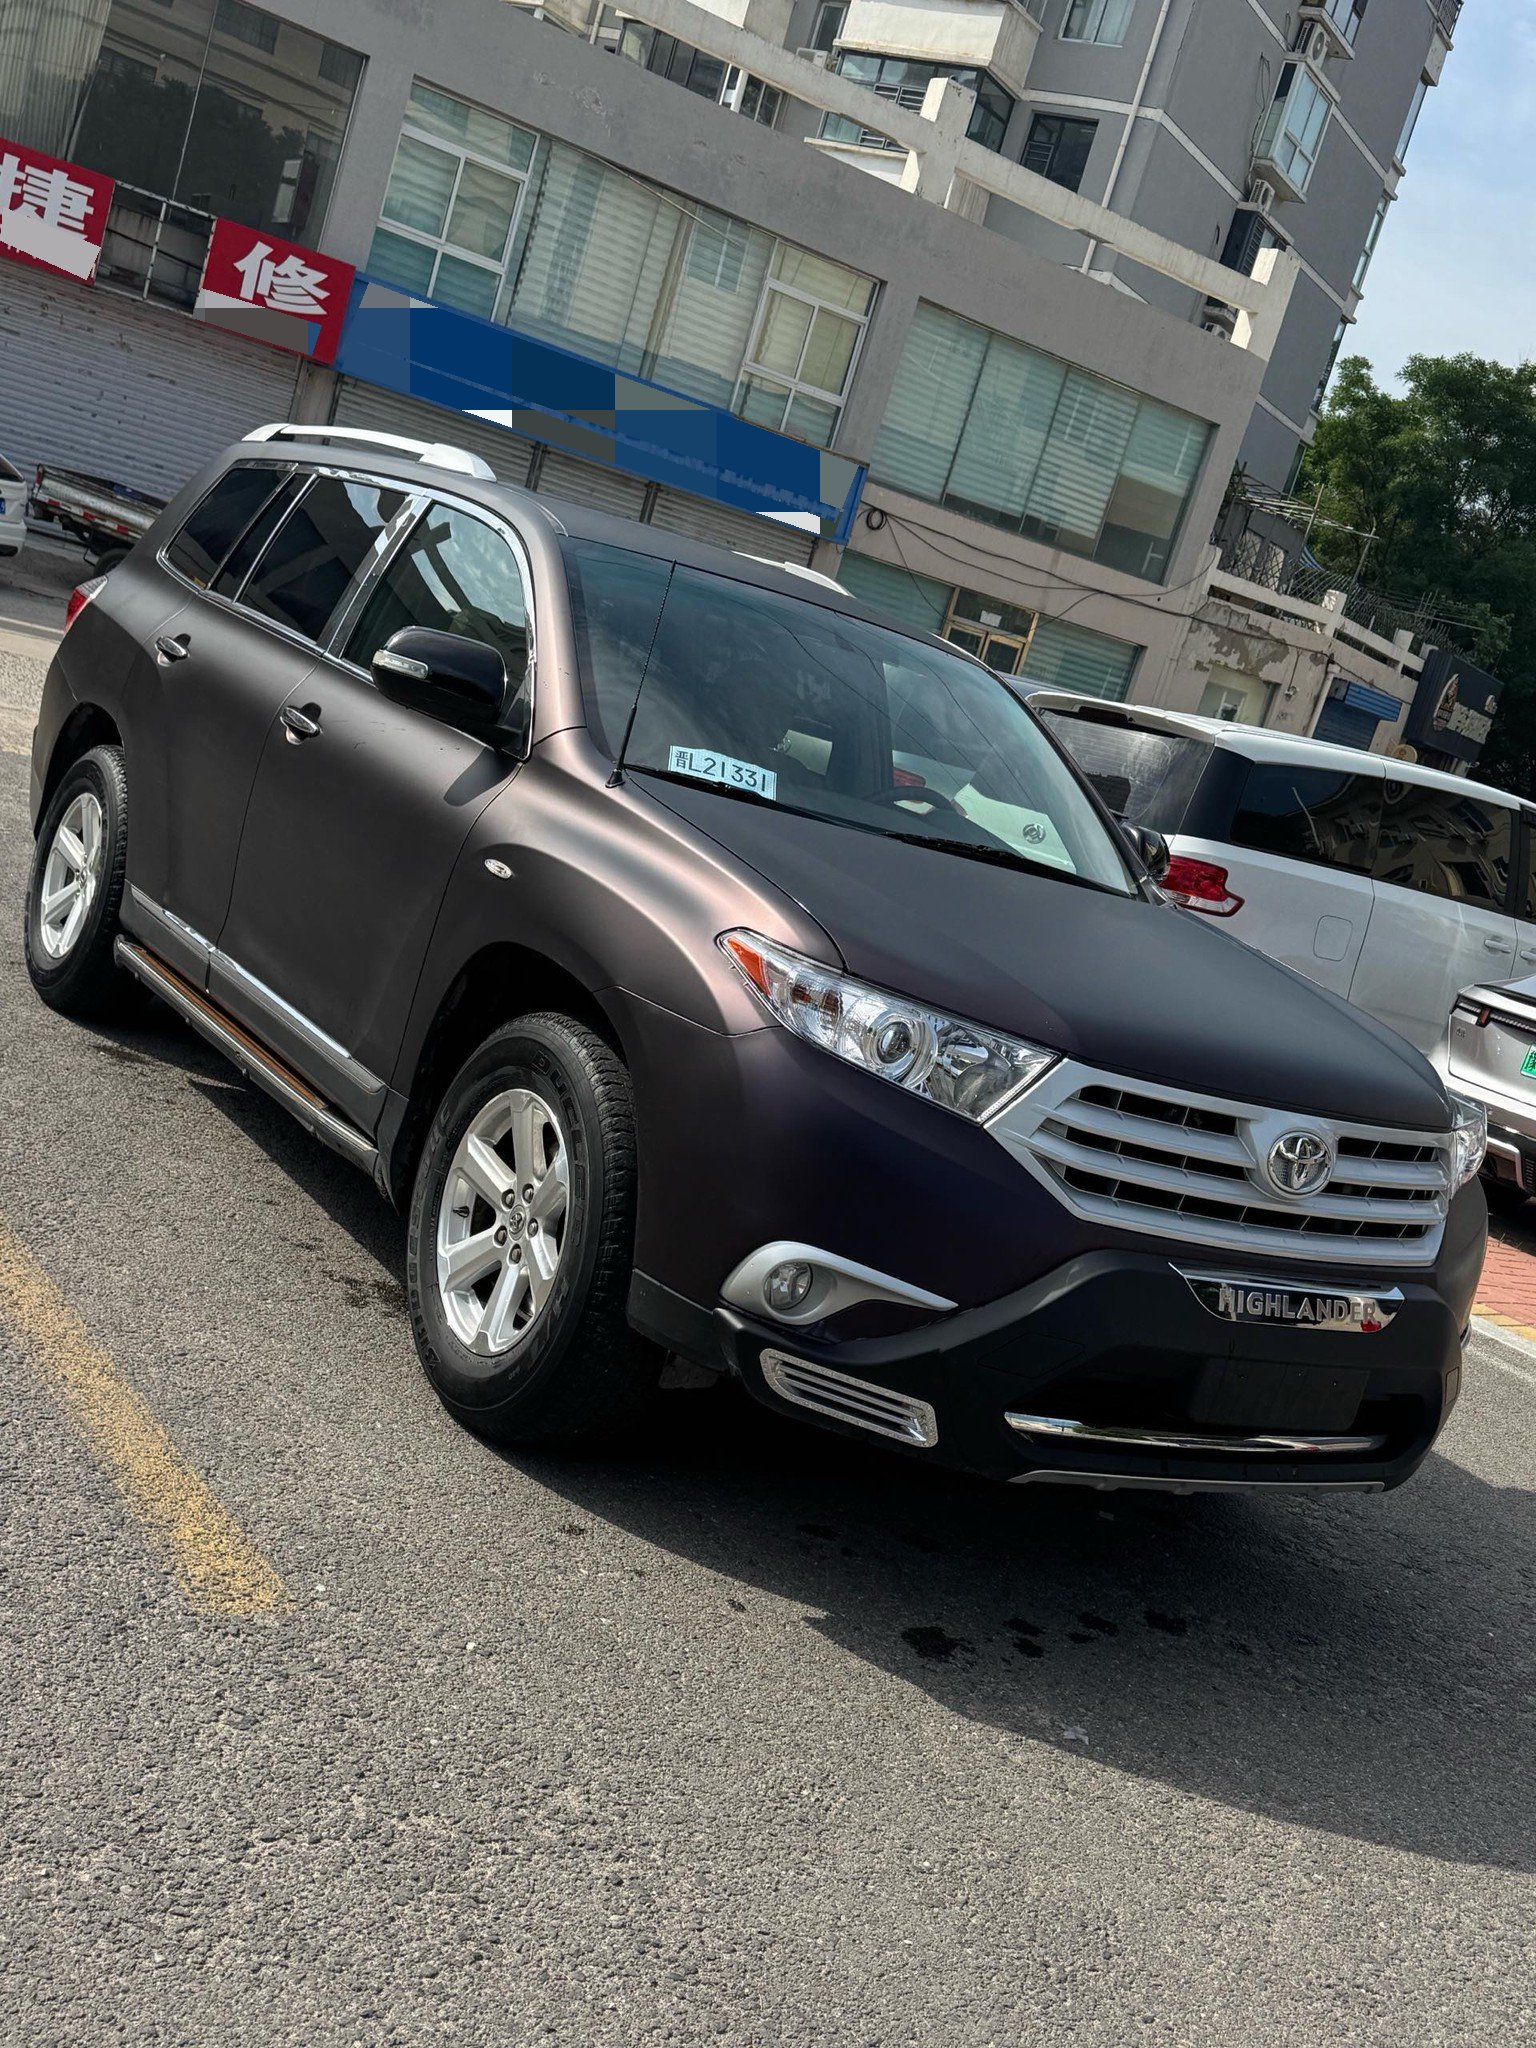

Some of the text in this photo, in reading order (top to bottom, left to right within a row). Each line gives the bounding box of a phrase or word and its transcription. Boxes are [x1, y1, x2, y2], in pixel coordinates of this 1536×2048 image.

[233, 240, 331, 316] 修
[675, 750, 766, 792] 晋L21331
[1218, 1285, 1376, 1323] HIGHLANDER
